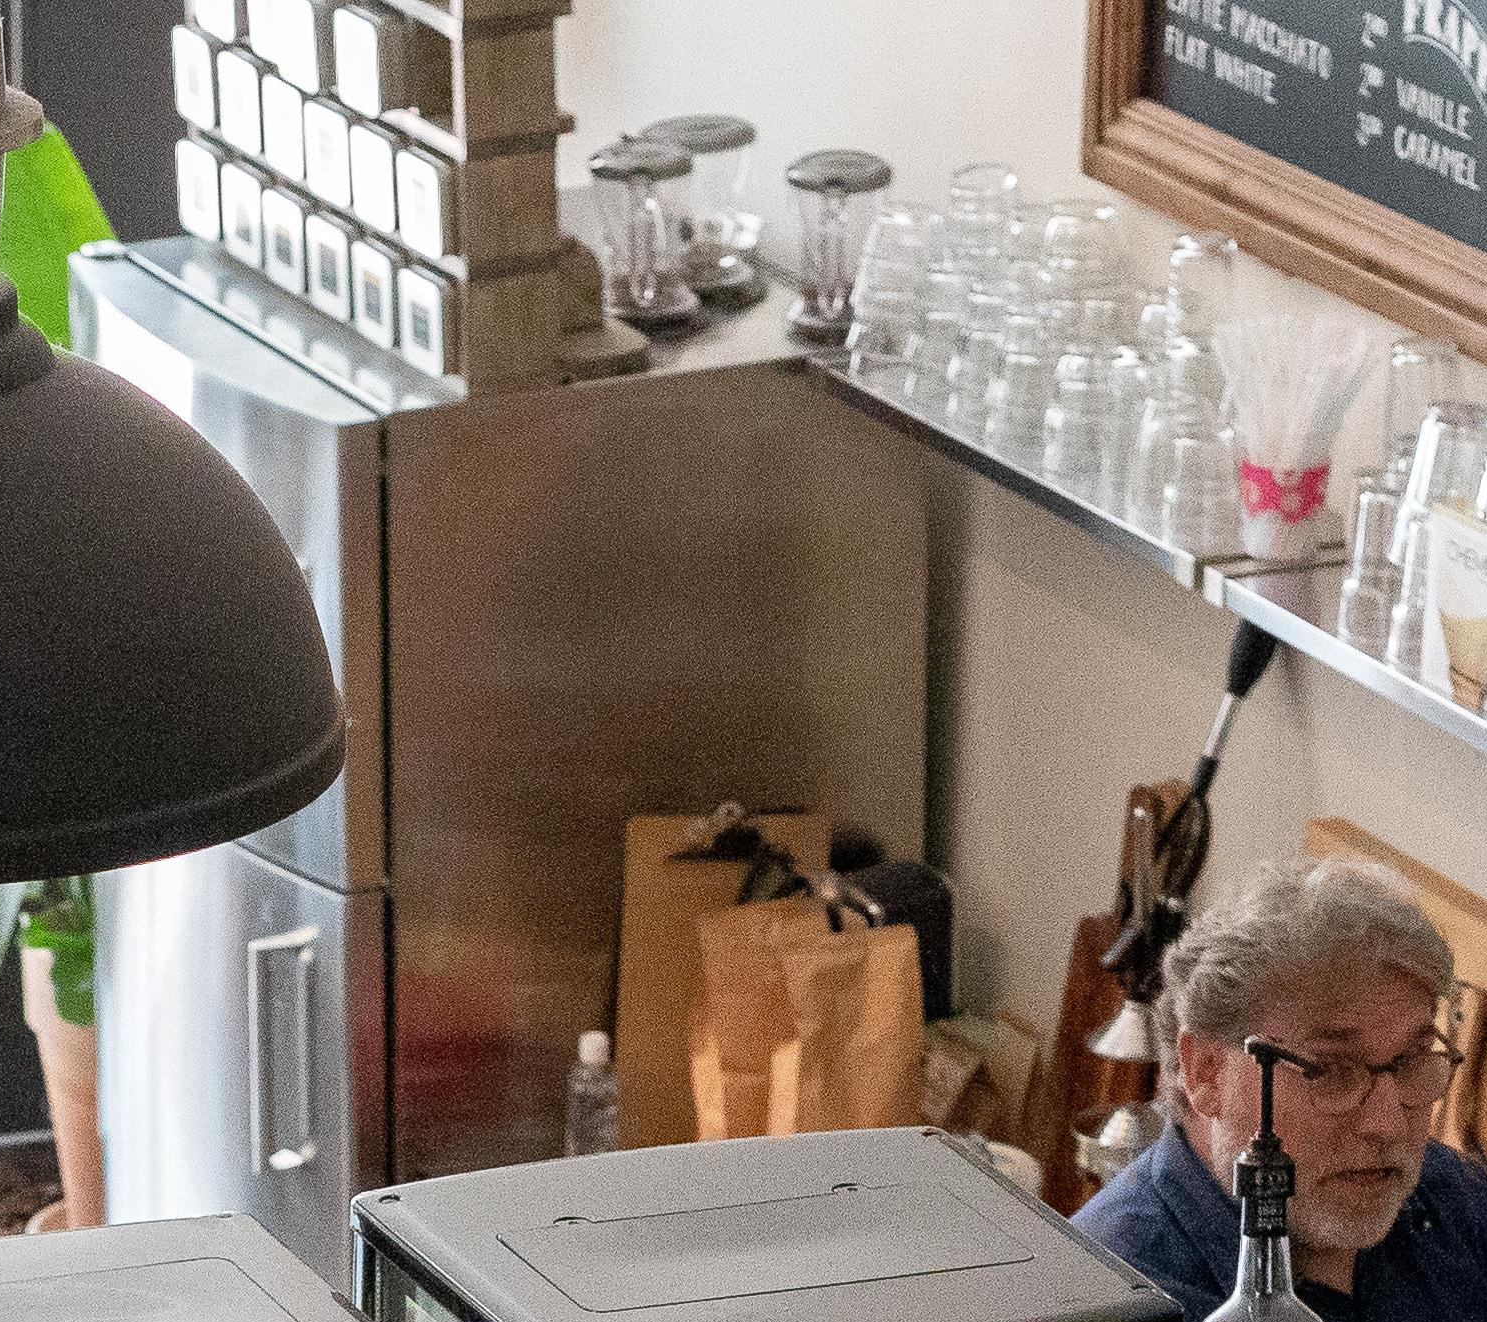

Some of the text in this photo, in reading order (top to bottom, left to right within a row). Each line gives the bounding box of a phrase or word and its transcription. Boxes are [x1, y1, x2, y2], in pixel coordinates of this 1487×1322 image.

[1164, 24, 1210, 71] FLAT
[1213, 46, 1279, 105] WHITE
[1230, 3, 1333, 80] MACCHIATO
[1395, 77, 1472, 141] VANILLE
[1393, 124, 1481, 192] CARAMEL
